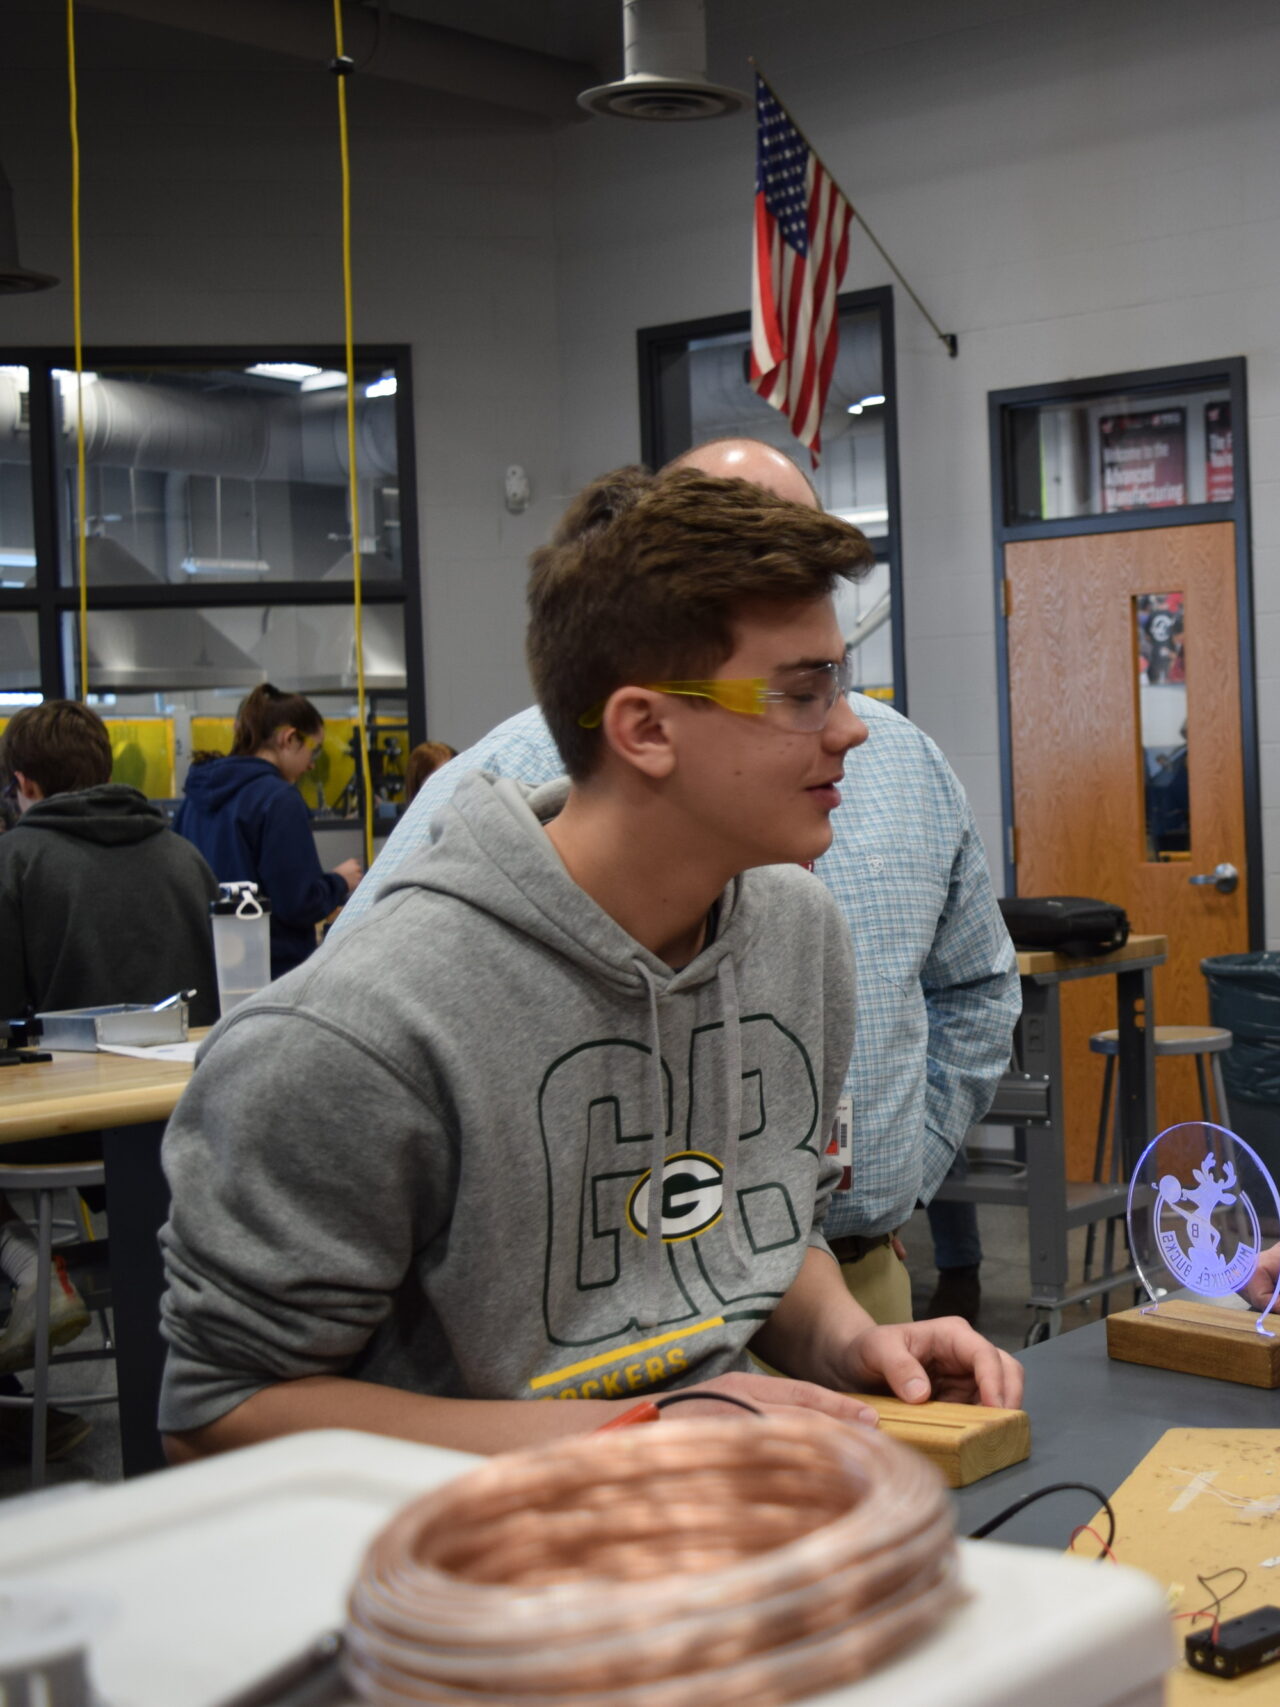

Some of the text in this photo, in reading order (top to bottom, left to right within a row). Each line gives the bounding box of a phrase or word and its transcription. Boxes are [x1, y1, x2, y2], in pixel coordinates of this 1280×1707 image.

[1106, 463, 1155, 484] Advanced
[1107, 483, 1183, 506] Manufacturing
[538, 1348, 688, 1400] ACKERS
